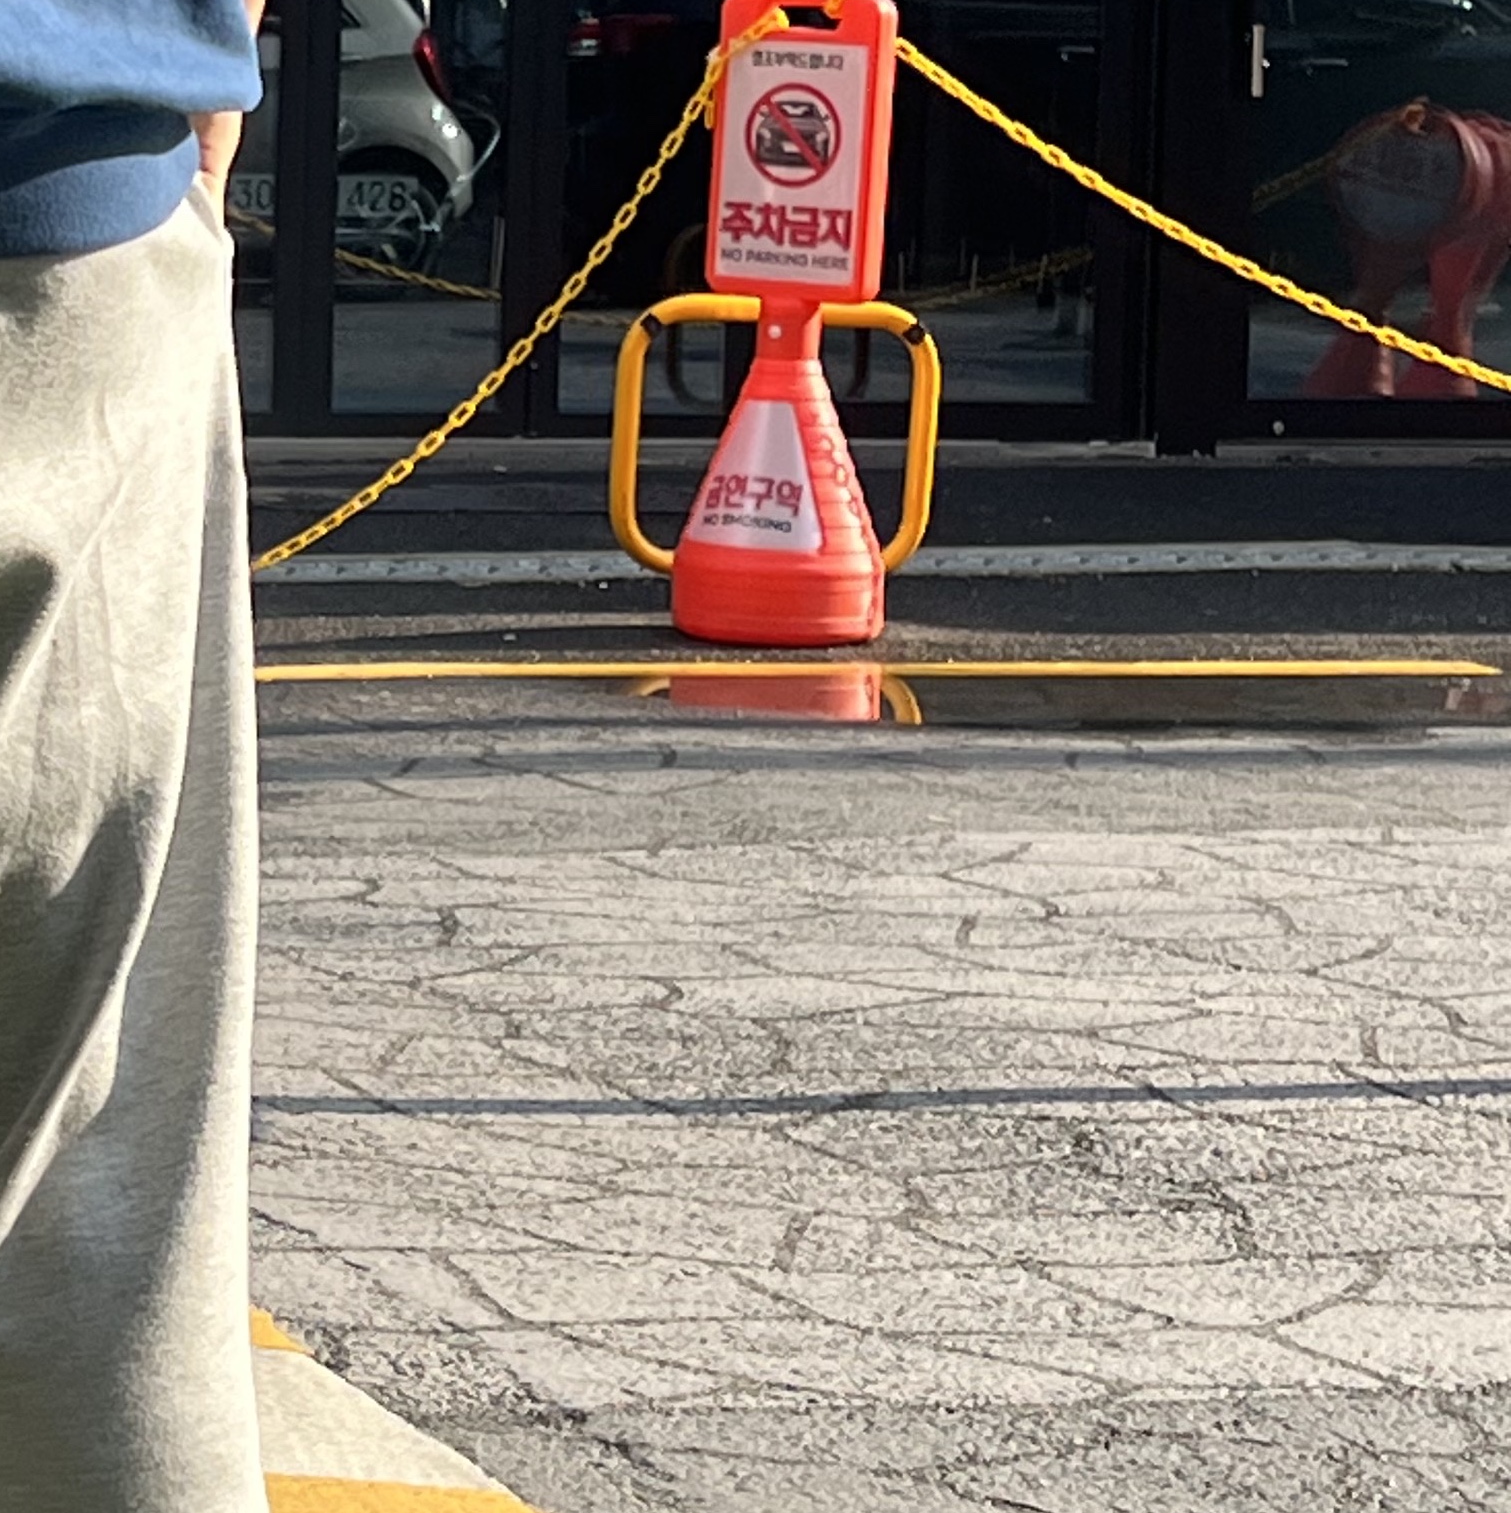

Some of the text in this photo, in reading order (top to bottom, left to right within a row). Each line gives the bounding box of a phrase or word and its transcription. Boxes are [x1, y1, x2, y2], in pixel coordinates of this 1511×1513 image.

[719, 202, 853, 252] 주차금지
[721, 248, 848, 271] NO PARKING HERE
[705, 474, 803, 517] 금연구역
[702, 514, 792, 533] NO SMOKING
